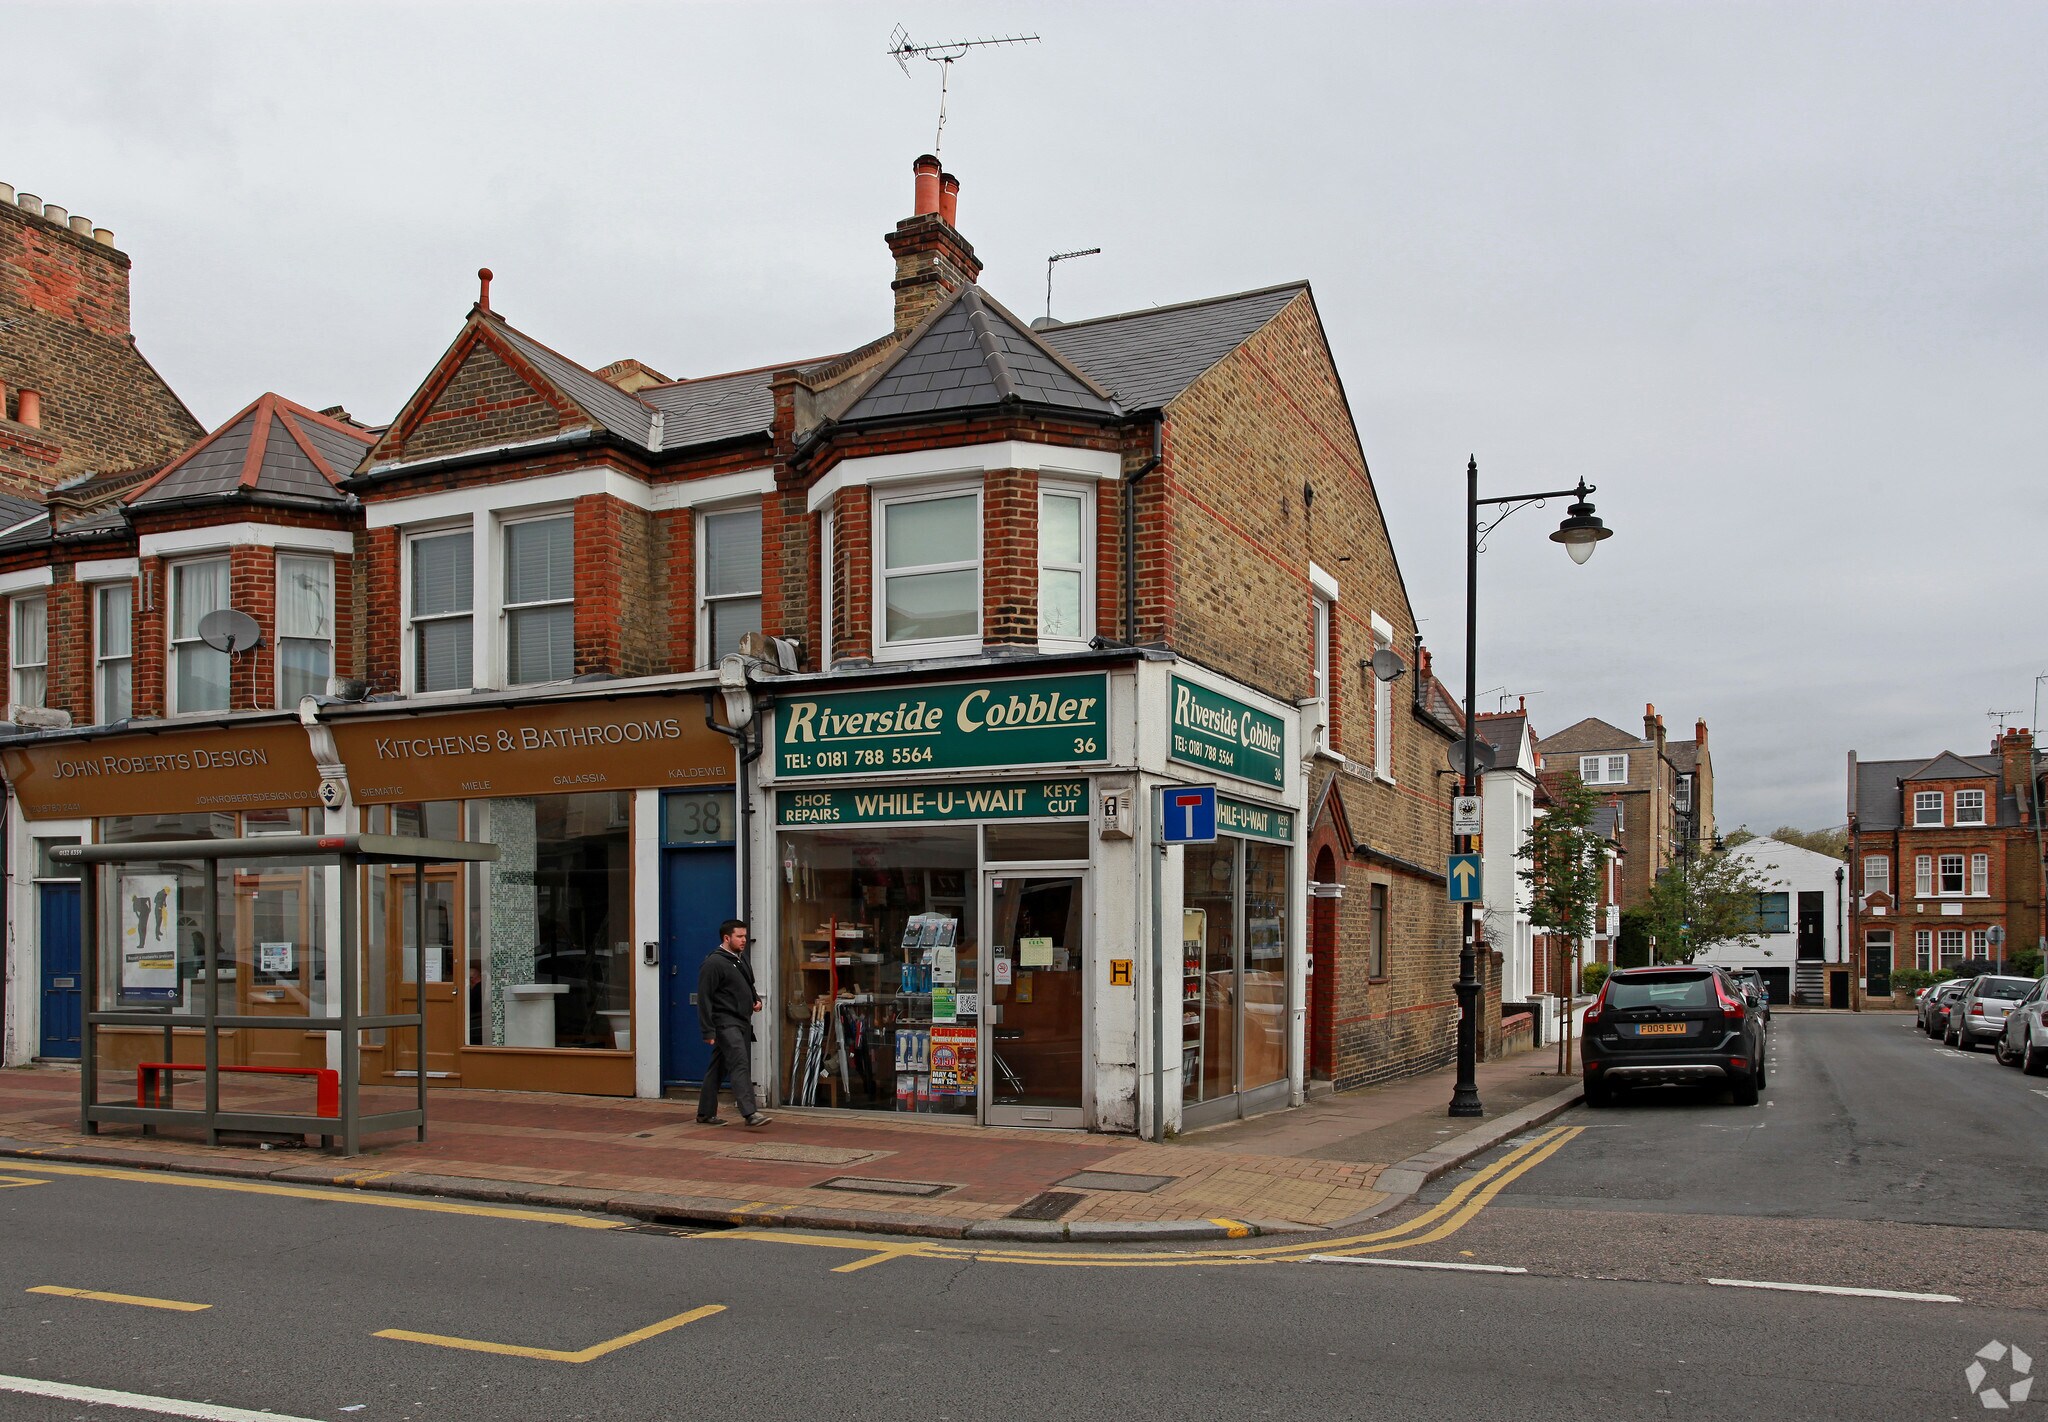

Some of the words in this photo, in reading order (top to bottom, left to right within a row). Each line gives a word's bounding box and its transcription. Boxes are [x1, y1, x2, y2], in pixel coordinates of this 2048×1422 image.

[784, 701, 944, 744] Riverside
[956, 689, 1097, 734] Cobbler
[1174, 684, 1238, 737] Riverside
[1240, 711, 1281, 753] Cobbler
[375, 733, 491, 760] KITCHENS
[496, 728, 516, 752] &
[520, 718, 682, 750] BATHROOMS
[1073, 738, 1097, 754] 36
[1174, 734, 1188, 751] TEL:
[1188, 739, 1203, 757] 0181
[1204, 744, 1217, 761] 788
[1218, 748, 1234, 766] 5564
[52, 759, 101, 779] JOHN
[102, 753, 191, 776] ROBERTS
[194, 748, 269, 770] DESIGN
[784, 754, 812, 769] TEL:
[816, 752, 848, 767] 0181
[854, 750, 885, 766] 788
[891, 747, 933, 764] 5564
[552, 773, 607, 785] GALASSIA
[668, 766, 727, 779] KALDEWEI
[1274, 767, 1282, 782] 36
[360, 786, 404, 797] SIEMATIC
[460, 780, 492, 791] MIELE
[1043, 784, 1082, 798] KEYS
[794, 794, 832, 806] SHOE
[854, 788, 1027, 816] WHILE-U-WAIT
[1047, 799, 1077, 814] CUT
[683, 799, 721, 836] 38
[785, 808, 840, 822] REPAIRS
[1277, 814, 1289, 825] KEYS
[1278, 828, 1288, 838] CUT
[1113, 961, 1129, 982] H
[1667, 1023, 1685, 1032] EVV
